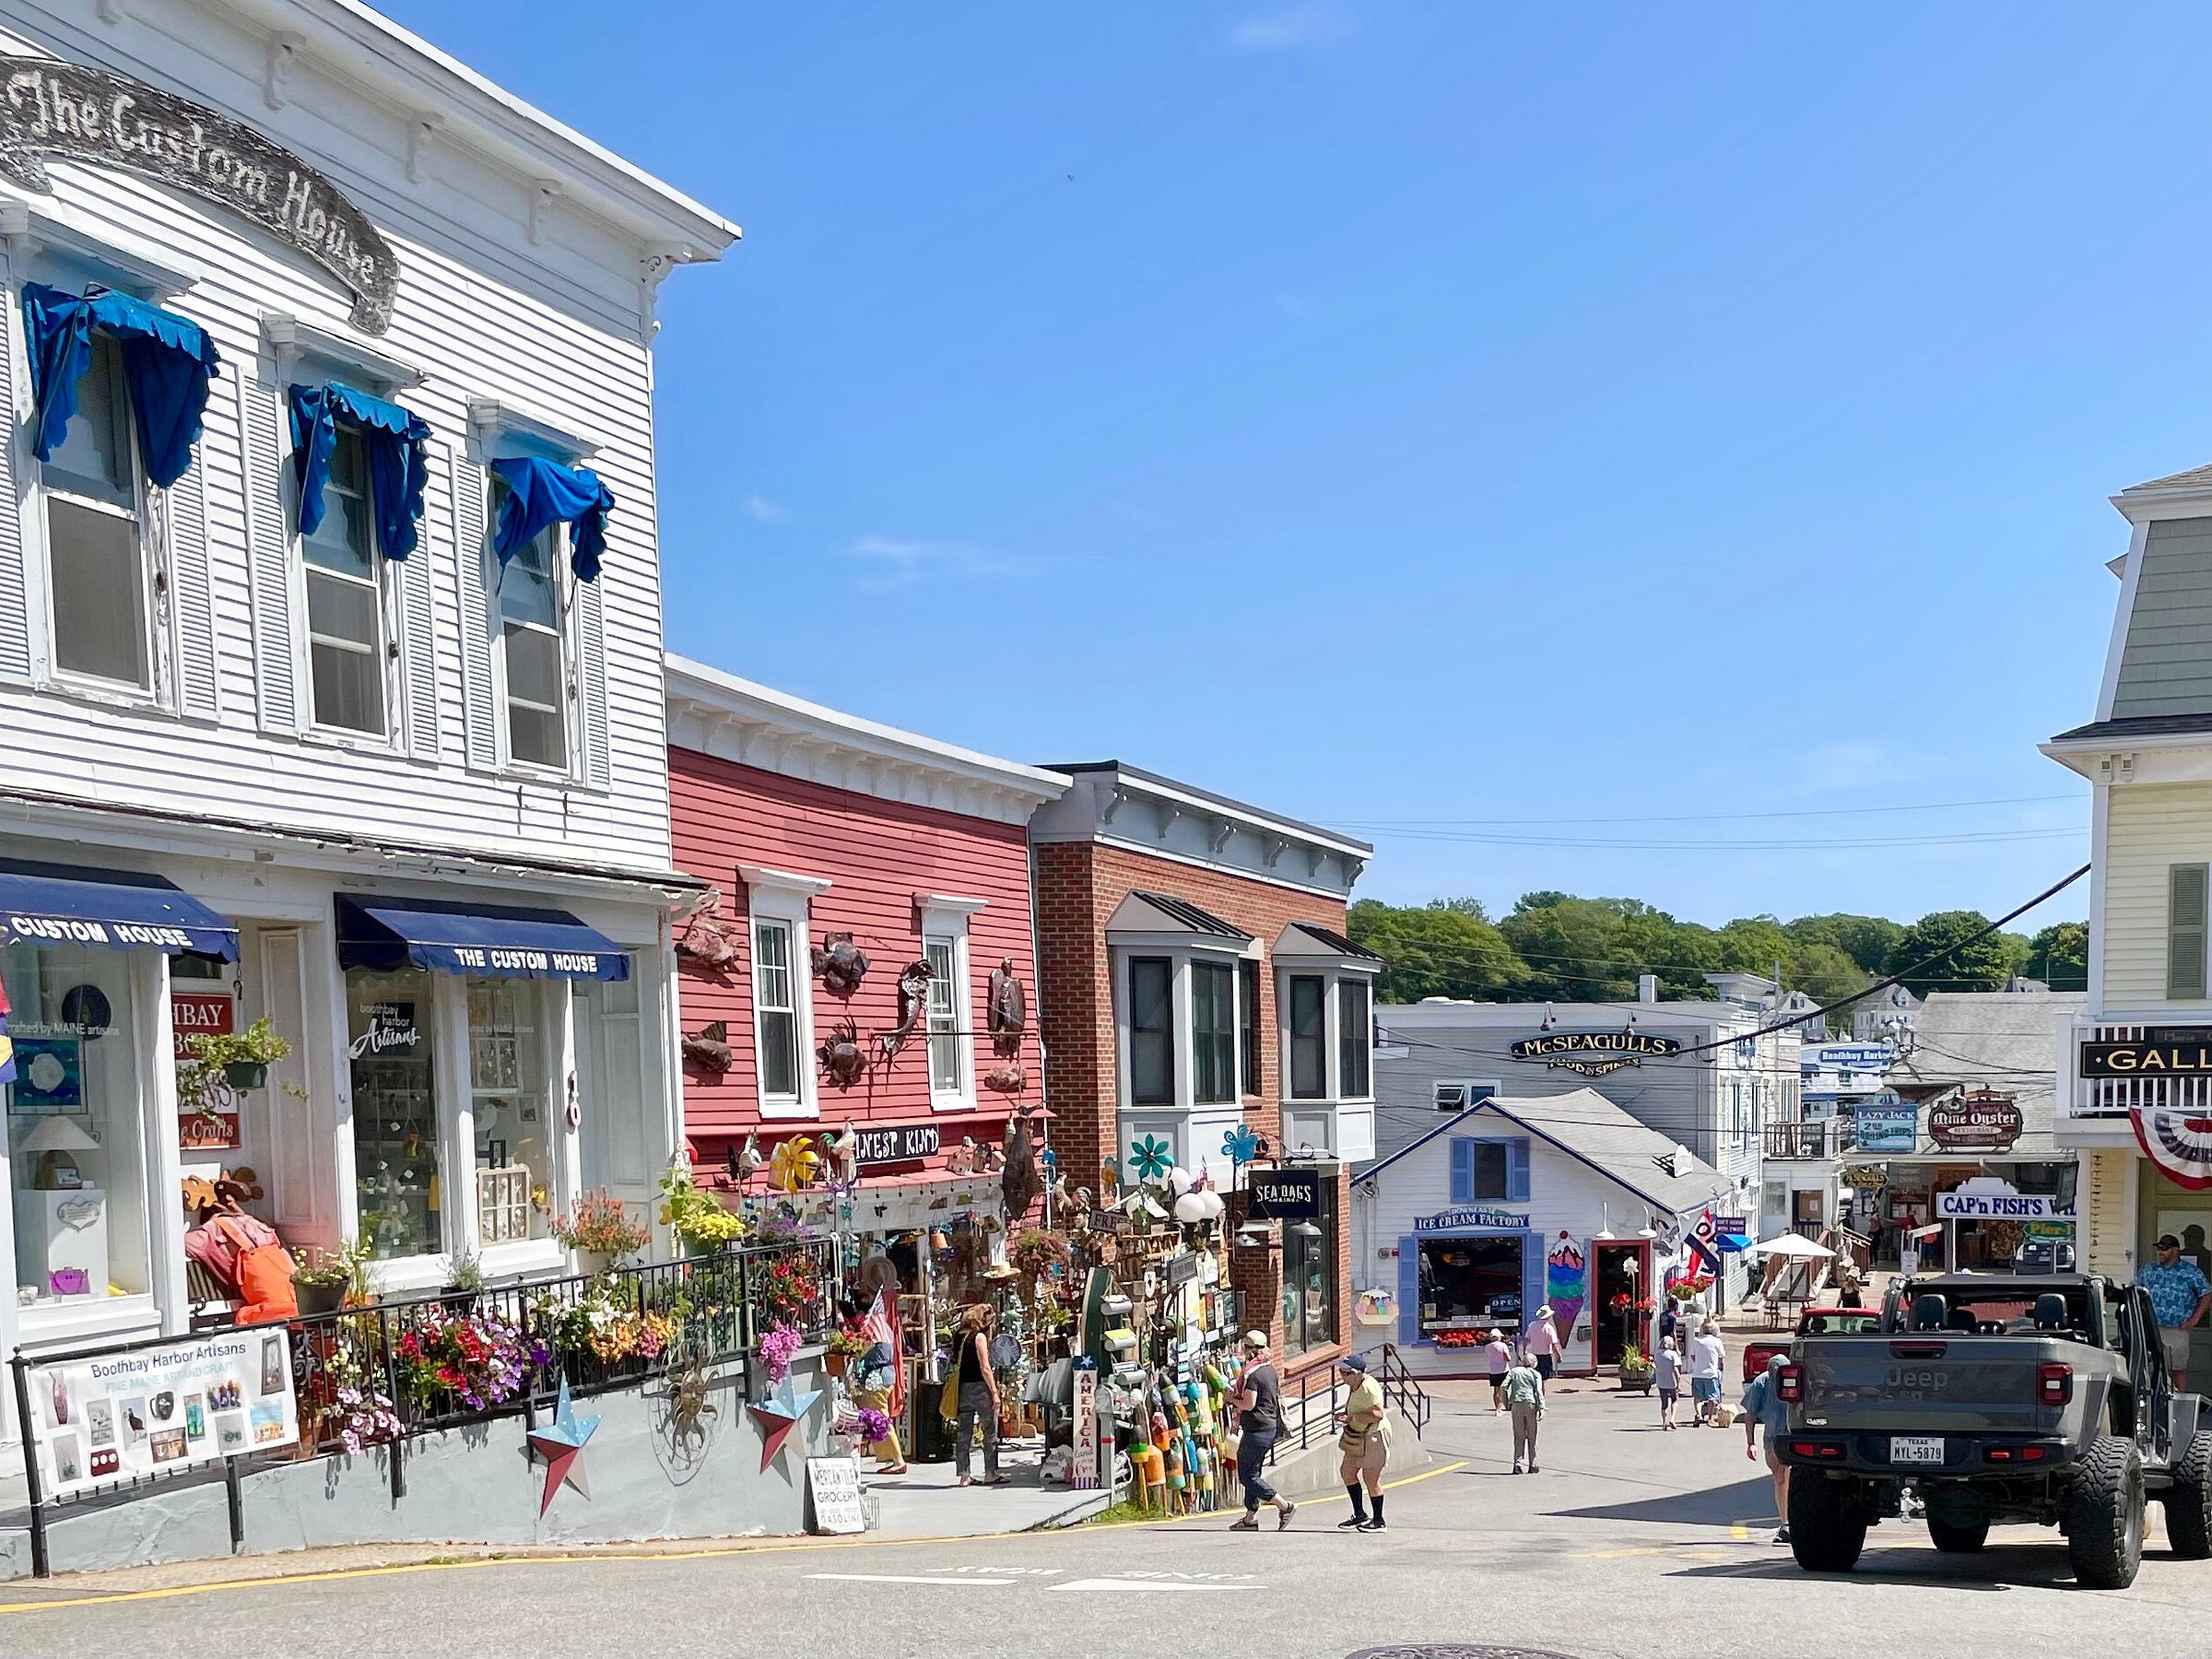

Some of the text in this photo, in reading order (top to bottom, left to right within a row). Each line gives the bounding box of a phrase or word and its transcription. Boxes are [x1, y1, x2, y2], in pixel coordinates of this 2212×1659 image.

[6, 70, 375, 285] The Custom House
[10, 916, 111, 943] CUSTOM
[113, 923, 194, 947] HOUSE
[454, 947, 597, 972] THE CUSTOM HOUSE
[359, 1002, 399, 1019] boothbay
[53, 1022, 85, 1034] MAINE
[382, 1015, 409, 1028] harbor
[347, 1018, 421, 1059] Artisans
[1524, 1034, 1667, 1055] McSEAGULLS
[1858, 1111, 1915, 1119] LAZY JACK
[1932, 1112, 2016, 1125] Mine Oyster
[855, 1127, 939, 1159] INEST KIND
[1256, 1184, 1277, 1203] SEA
[1944, 1196, 1988, 1215] CAP'n
[1992, 1197, 2042, 1216] FISH'S
[1418, 1213, 1526, 1230] ICE CREAM FACTORY
[1491, 1299, 1521, 1307] OPEN
[90, 1342, 246, 1379] Boothbay Harbor Artisans
[1887, 1367, 1948, 1391] Jeep
[1079, 1373, 1092, 1448] AMERICA
[817, 1491, 856, 1503] GROCERY
